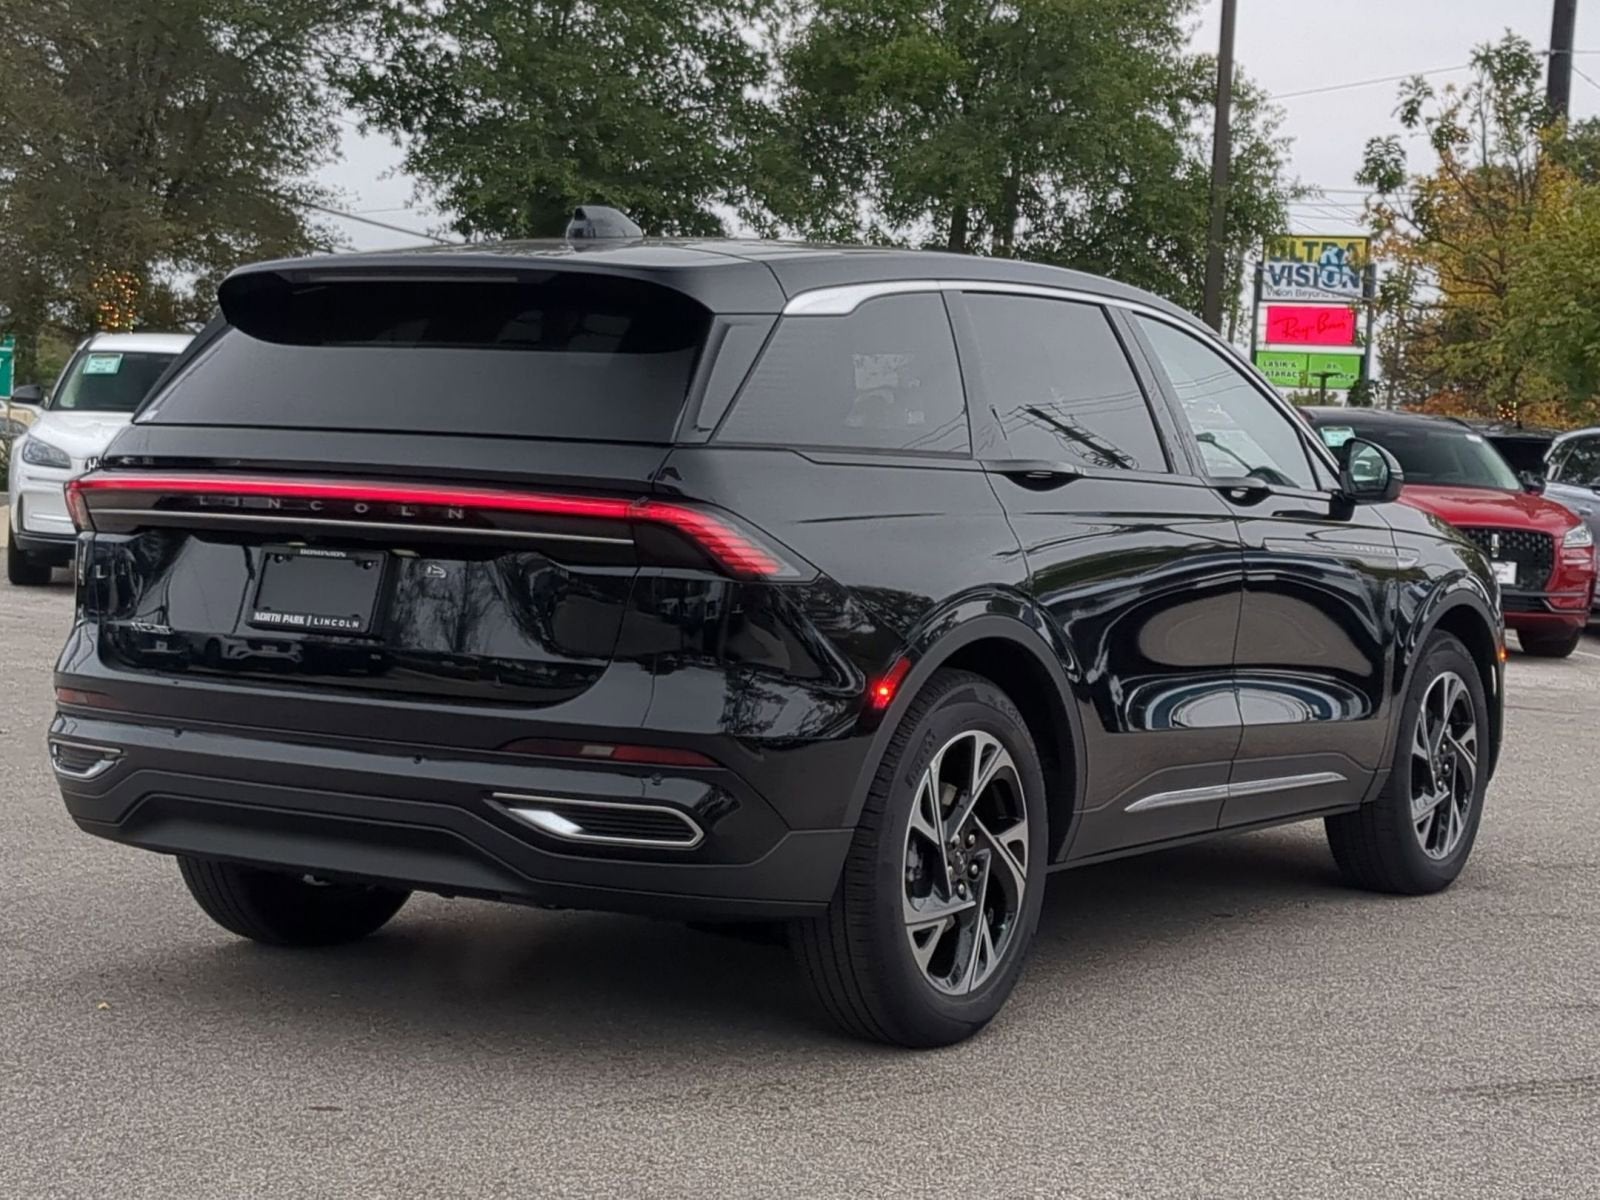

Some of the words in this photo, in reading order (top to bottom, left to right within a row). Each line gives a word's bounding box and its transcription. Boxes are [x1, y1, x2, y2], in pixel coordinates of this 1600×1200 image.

[1268, 264, 1360, 288] VISION
[199, 495, 464, 520] LINCOLN
[254, 611, 282, 623] NORTH
[282, 613, 306, 625] PARK
[314, 617, 359, 629] LINCOLN
